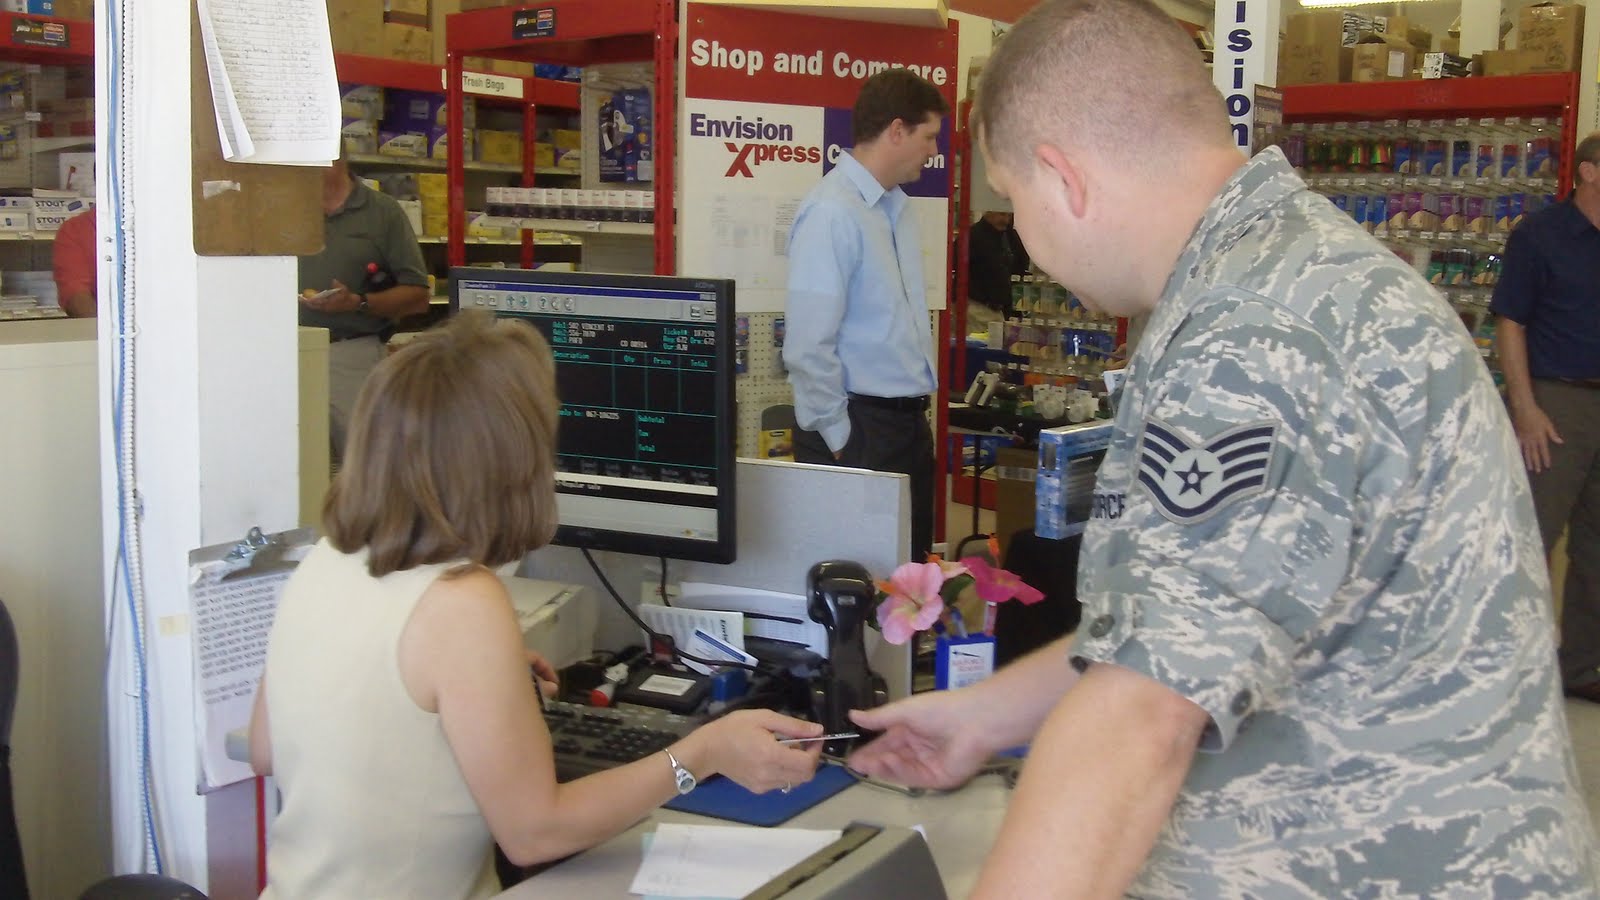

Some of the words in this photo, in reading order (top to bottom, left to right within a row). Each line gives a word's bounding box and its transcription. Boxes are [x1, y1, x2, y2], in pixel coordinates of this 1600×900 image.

[690, 39, 764, 76] Shop
[773, 50, 823, 76] and
[832, 52, 948, 86] Comare
[463, 76, 484, 87] Trash
[485, 79, 504, 92] Bags
[690, 113, 793, 141] Envision
[724, 142, 821, 178] Xpress
[691, 359, 709, 368] Total
[638, 414, 665, 424] Subtotal
[638, 444, 656, 453] Total
